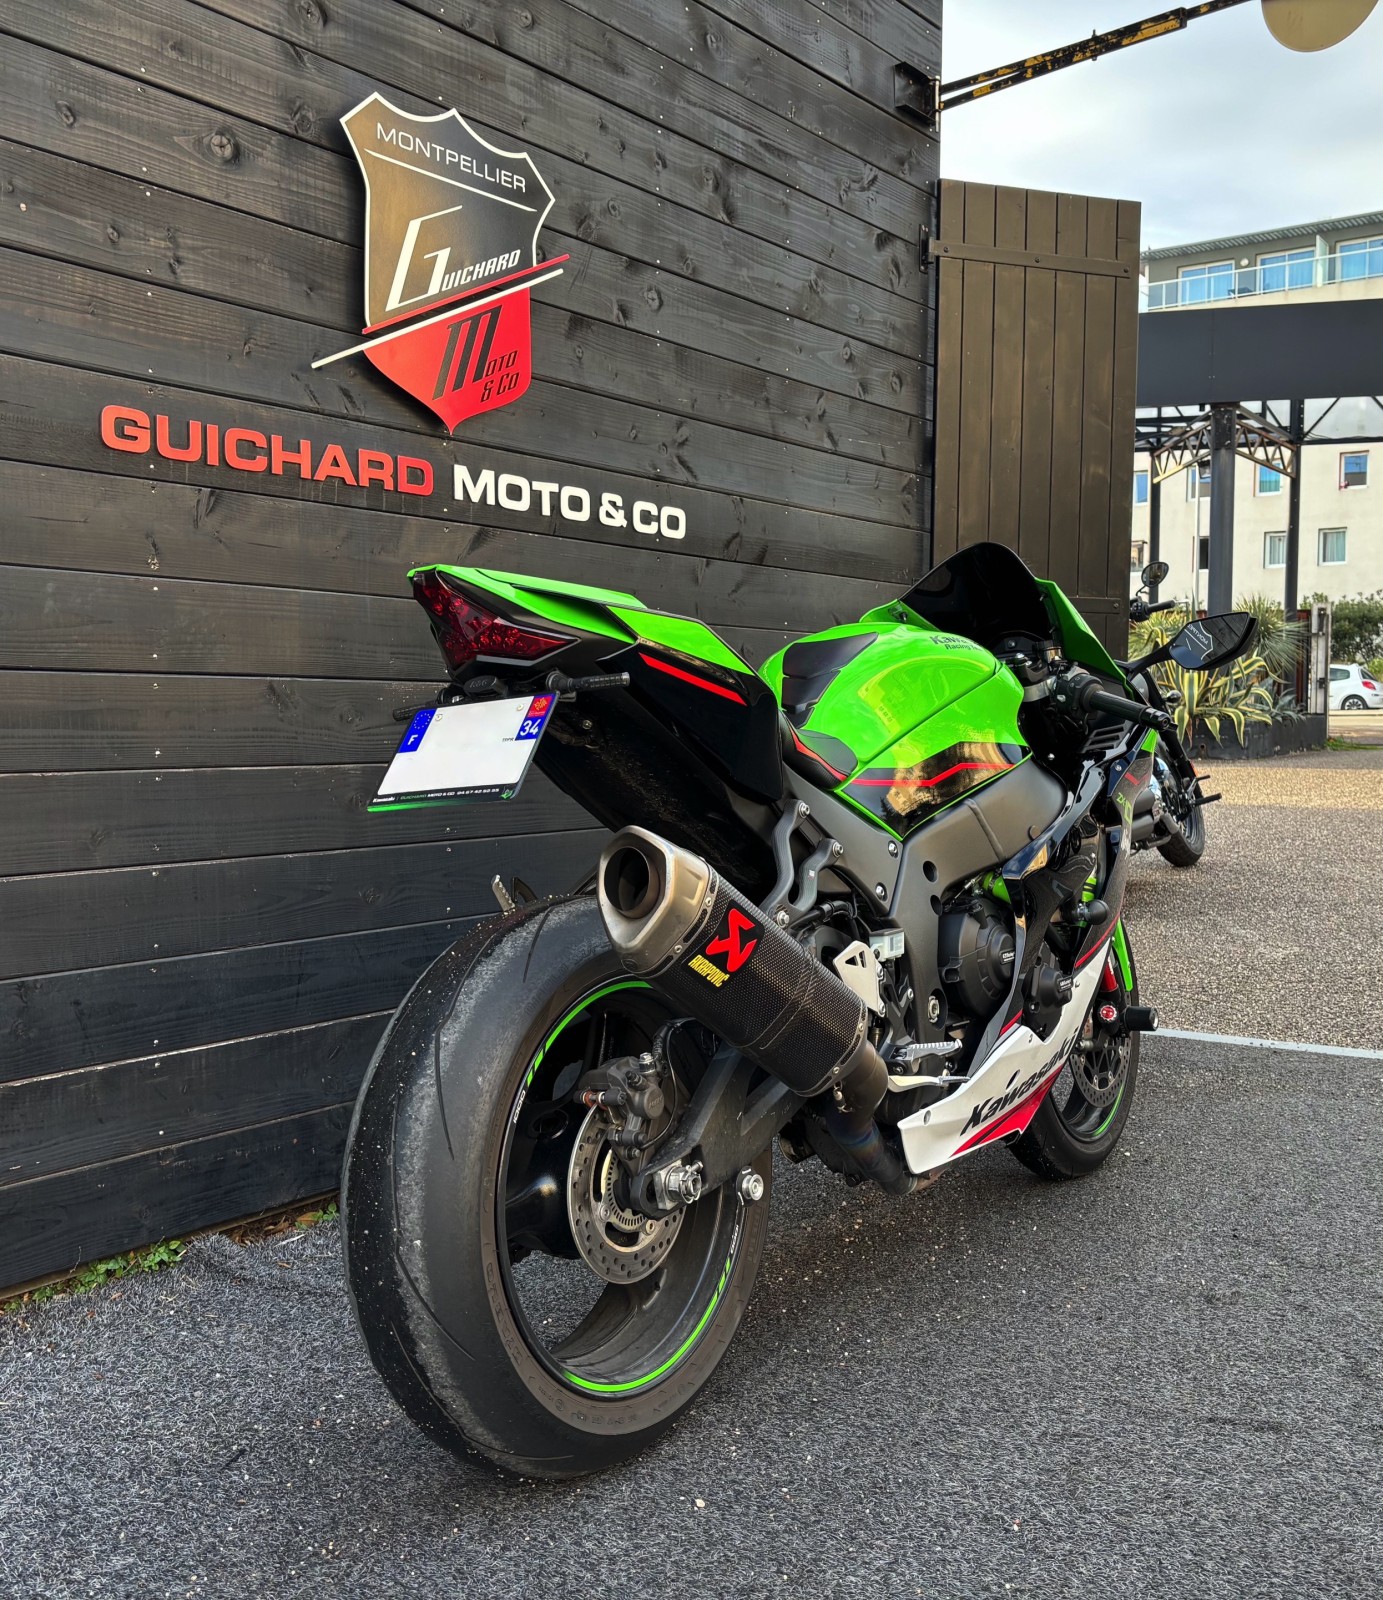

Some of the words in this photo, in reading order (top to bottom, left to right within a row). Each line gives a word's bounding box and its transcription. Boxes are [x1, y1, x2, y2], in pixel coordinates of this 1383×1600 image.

[376, 122, 527, 193] MONTPELLIER
[385, 205, 521, 312] GUICHARD
[432, 304, 518, 401] MOTO
[100, 404, 434, 497] GUICHARD
[453, 464, 591, 523] MOTO
[600, 492, 628, 528] &
[632, 501, 687, 540] CO
[407, 734, 418, 746] F
[519, 718, 542, 736] 34
[959, 1026, 1079, 1137] Kawasaki
